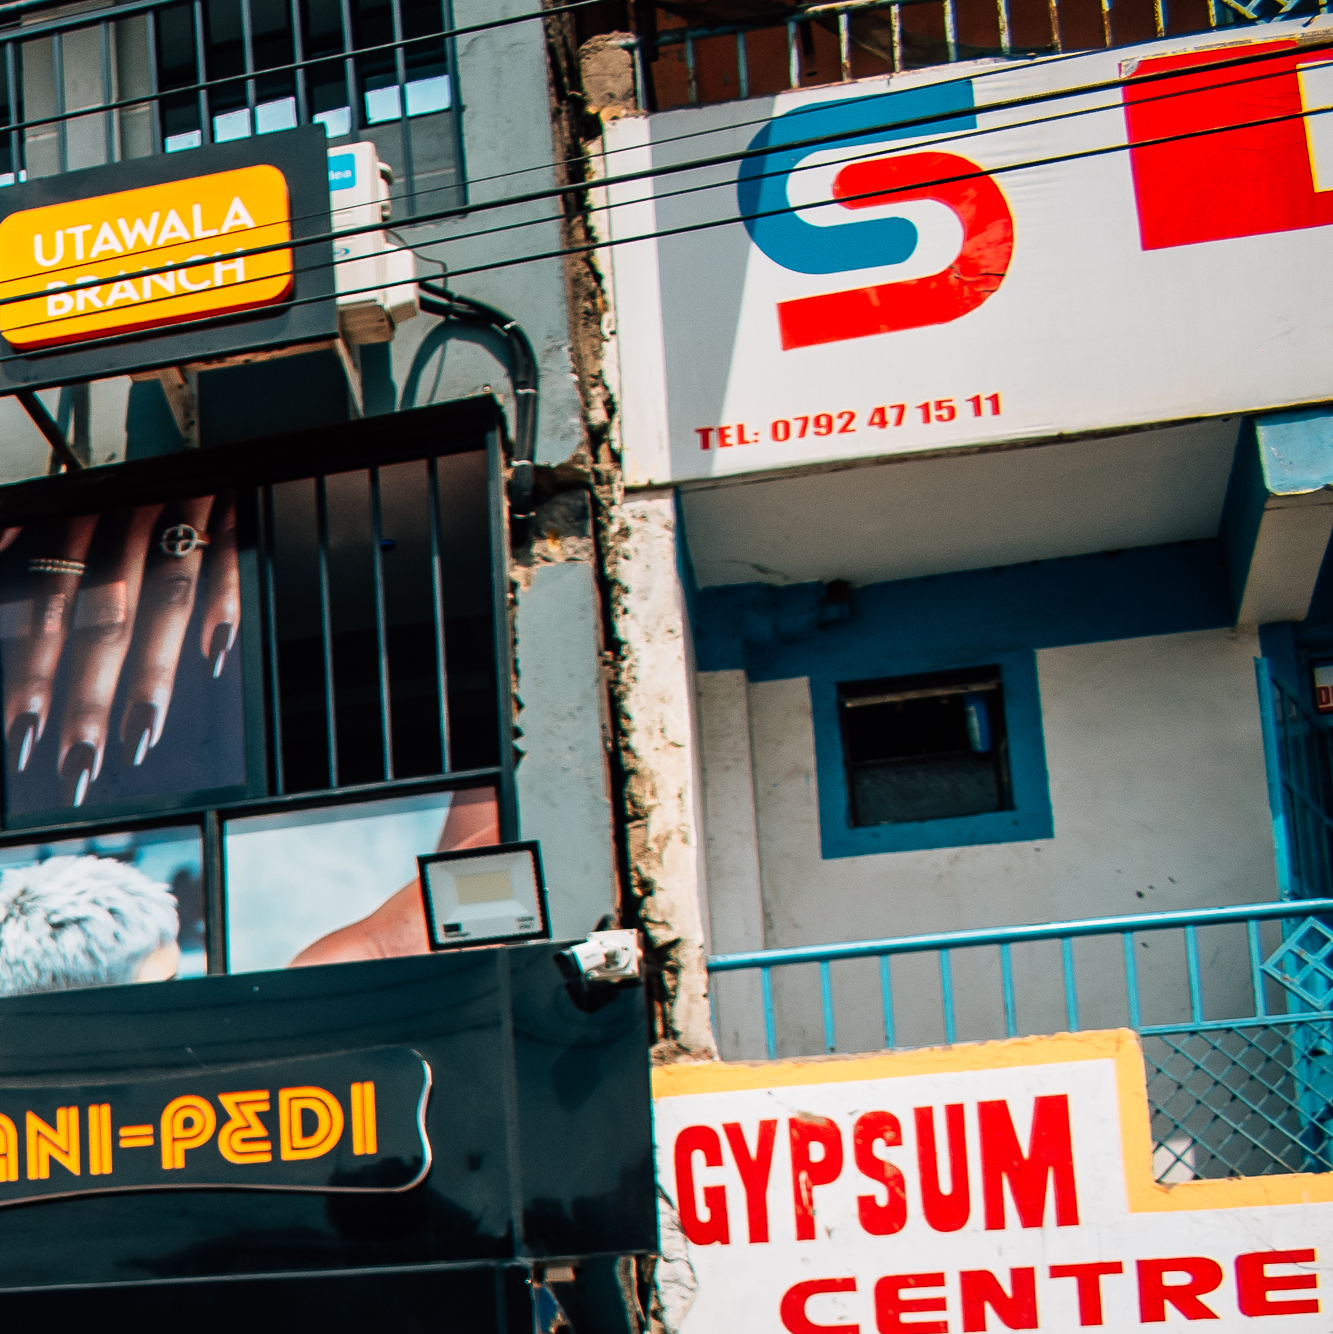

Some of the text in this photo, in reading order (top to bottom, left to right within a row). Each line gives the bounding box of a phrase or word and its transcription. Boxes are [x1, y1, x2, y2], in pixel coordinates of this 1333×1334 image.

[33, 196, 255, 316] UTAWALA BRANCH
[696, 393, 1001, 452] TEL: 0792 47 15 11
[674, 1094, 1079, 1245] GYPSUM
